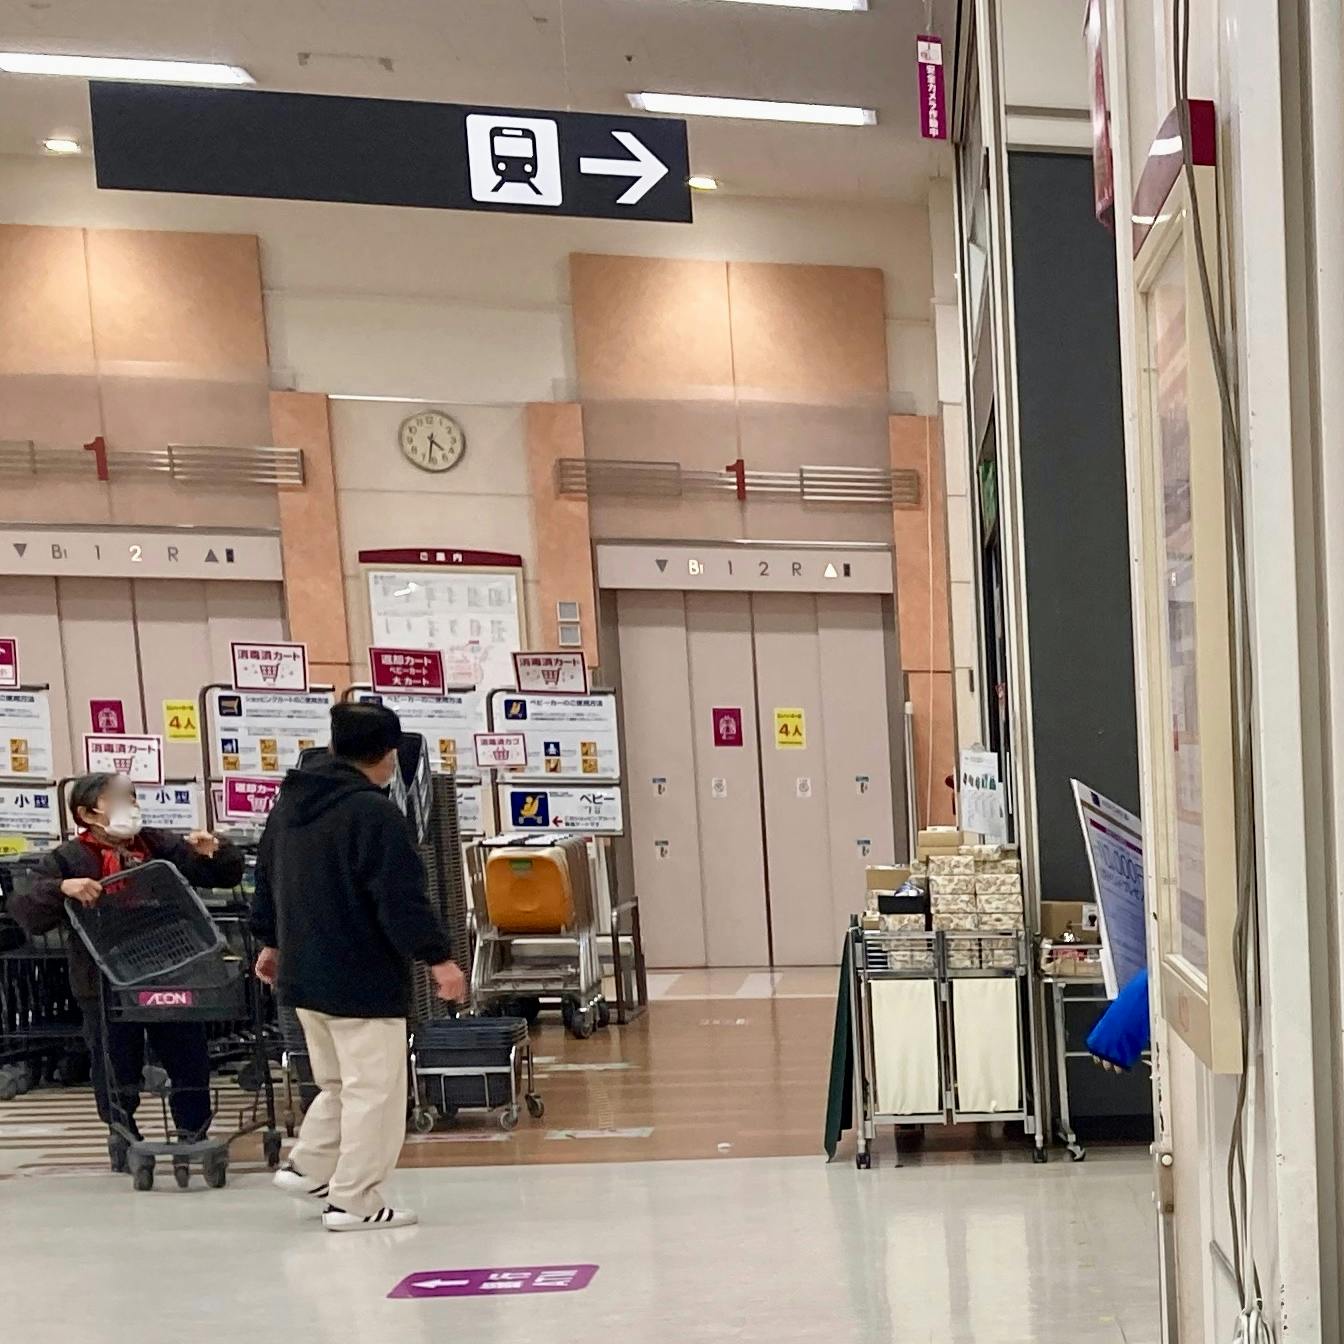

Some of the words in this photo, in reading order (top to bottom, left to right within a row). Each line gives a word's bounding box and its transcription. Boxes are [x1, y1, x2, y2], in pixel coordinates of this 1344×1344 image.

[83, 436, 109, 481] 1
[726, 459, 746, 500] 1
[129, 545, 143, 562] 2
[168, 546, 179, 561] R
[758, 561, 769, 577] 2
[792, 562, 801, 576] R
[381, 654, 432, 665] 返却カート
[169, 716, 195, 730] 4人
[778, 723, 802, 736] 4人
